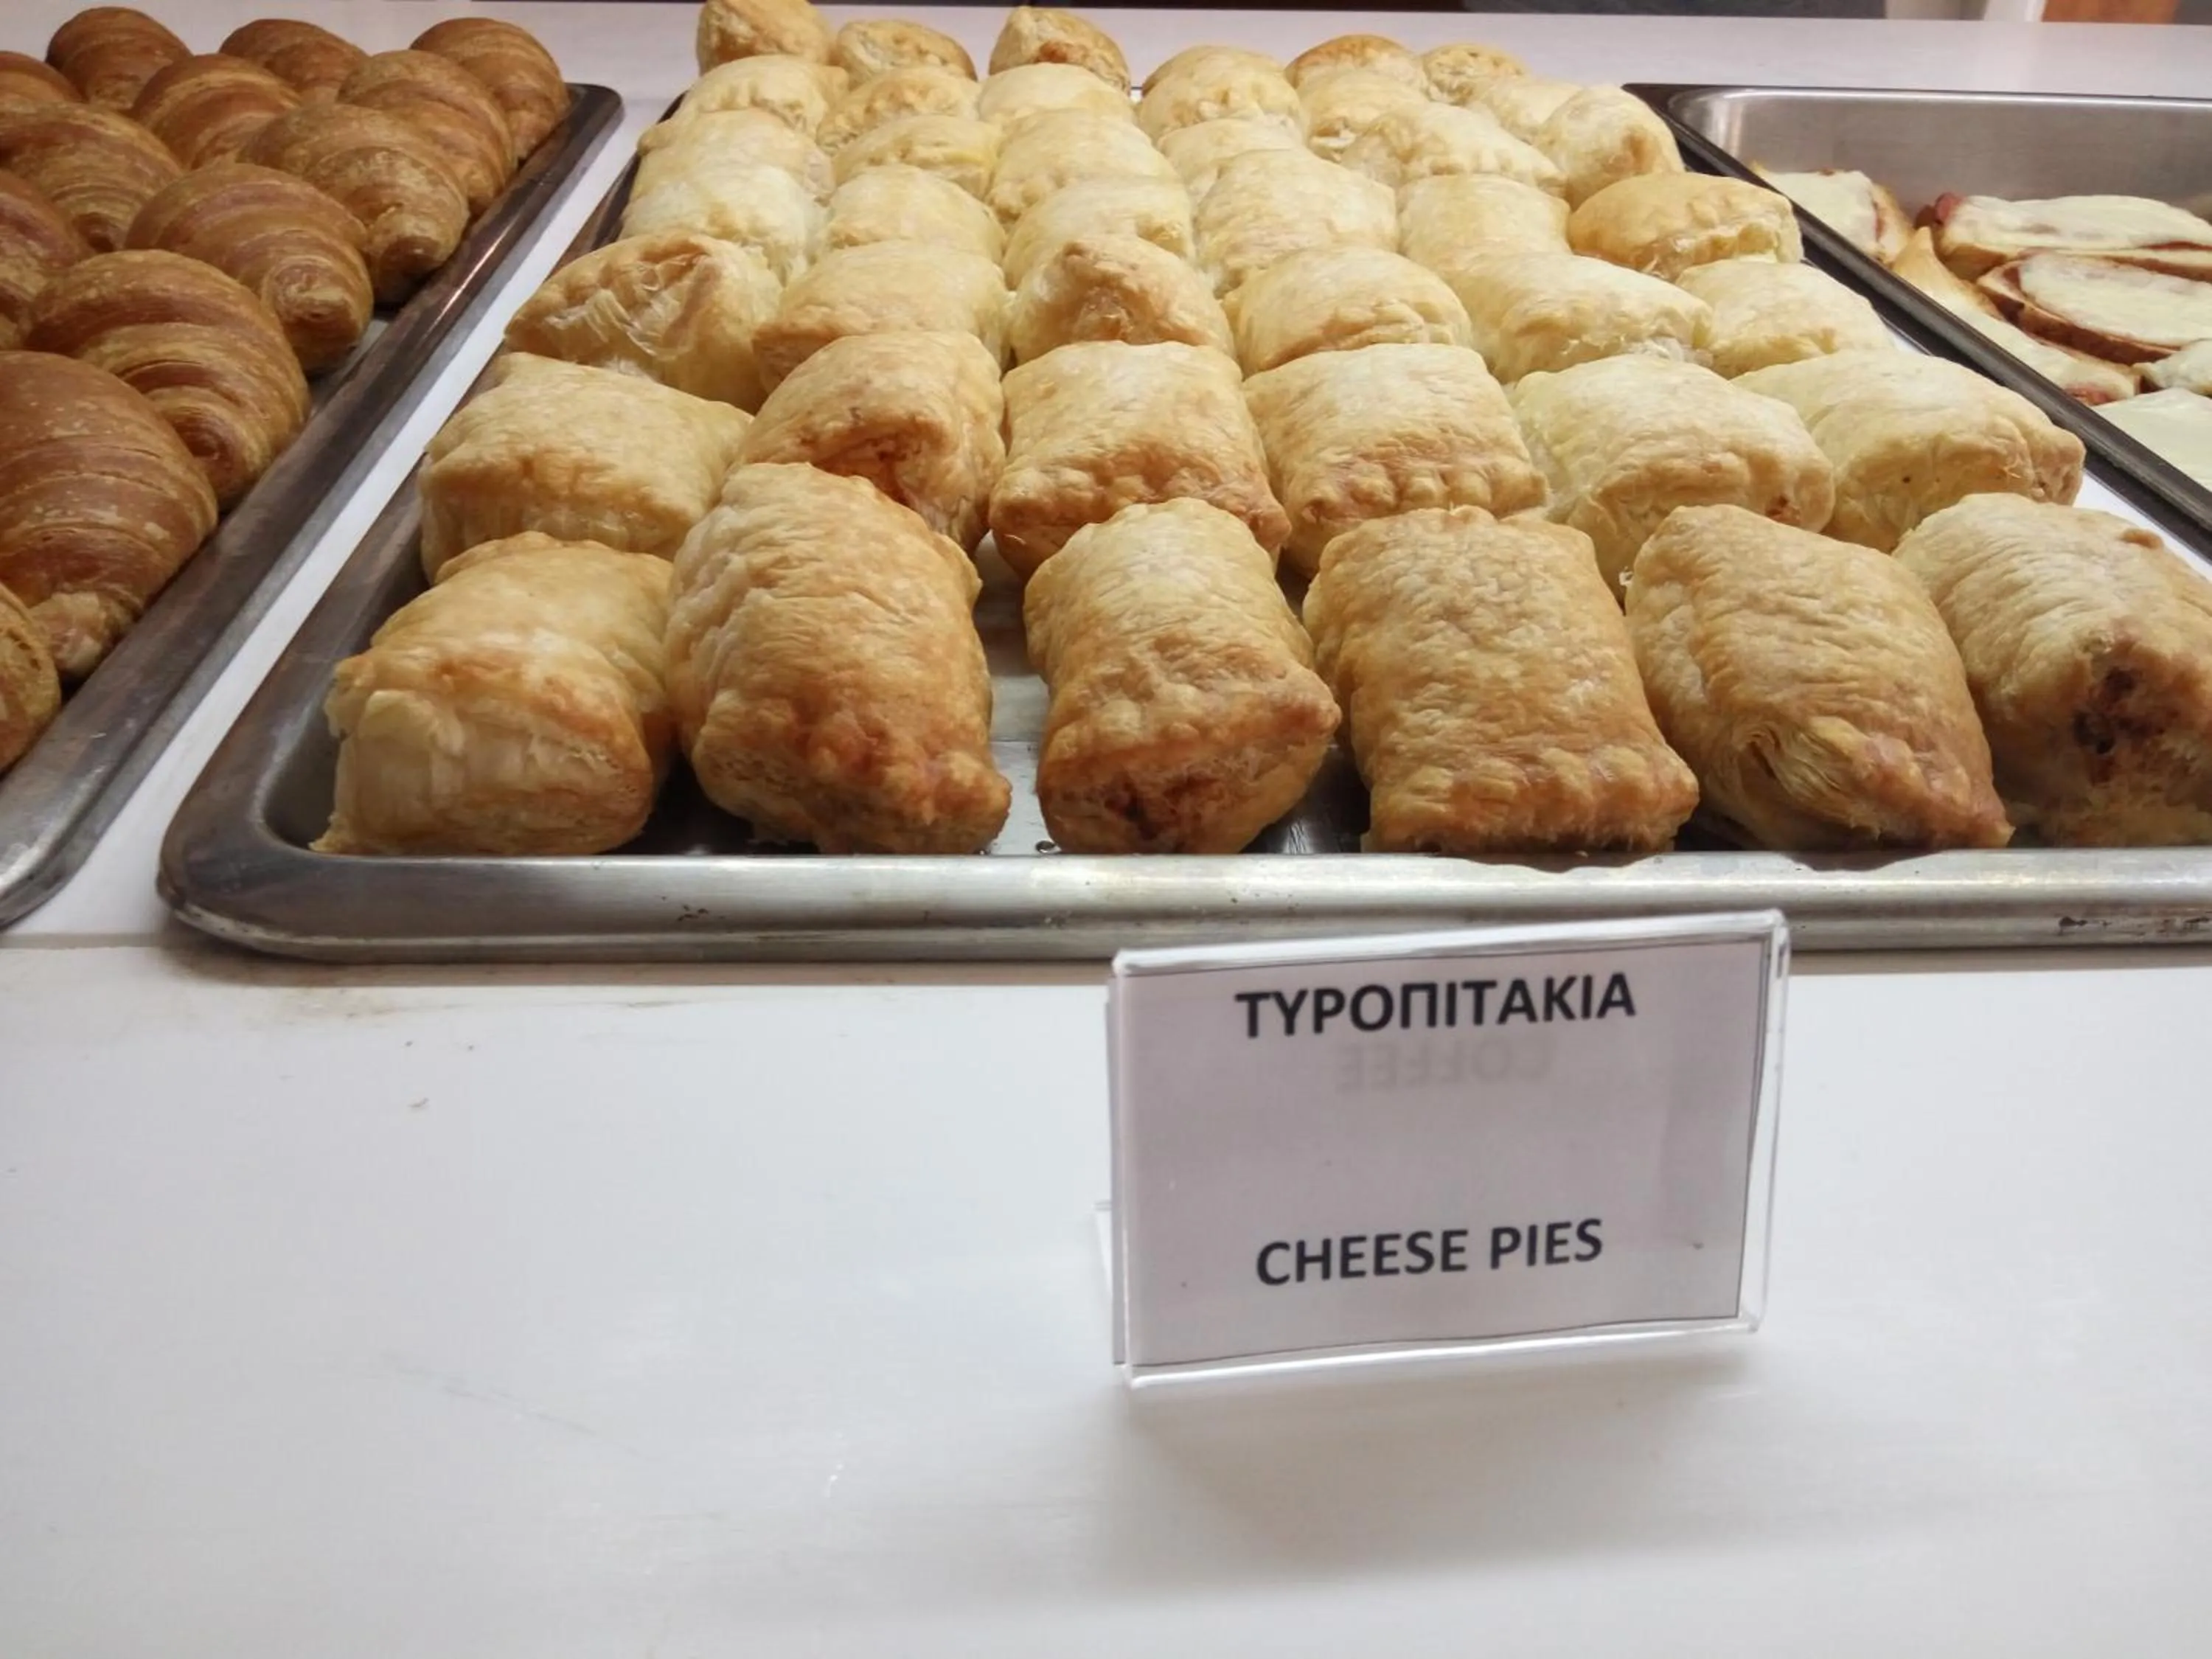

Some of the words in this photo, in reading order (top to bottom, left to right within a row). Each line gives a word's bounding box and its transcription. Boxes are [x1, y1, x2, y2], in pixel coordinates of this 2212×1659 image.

[1235, 972, 1636, 1038] ΤΥΡΟΠΙΤΑΚΙΑ
[1256, 1228, 1470, 1286] CHEESE
[1489, 1218, 1604, 1271] PIES
